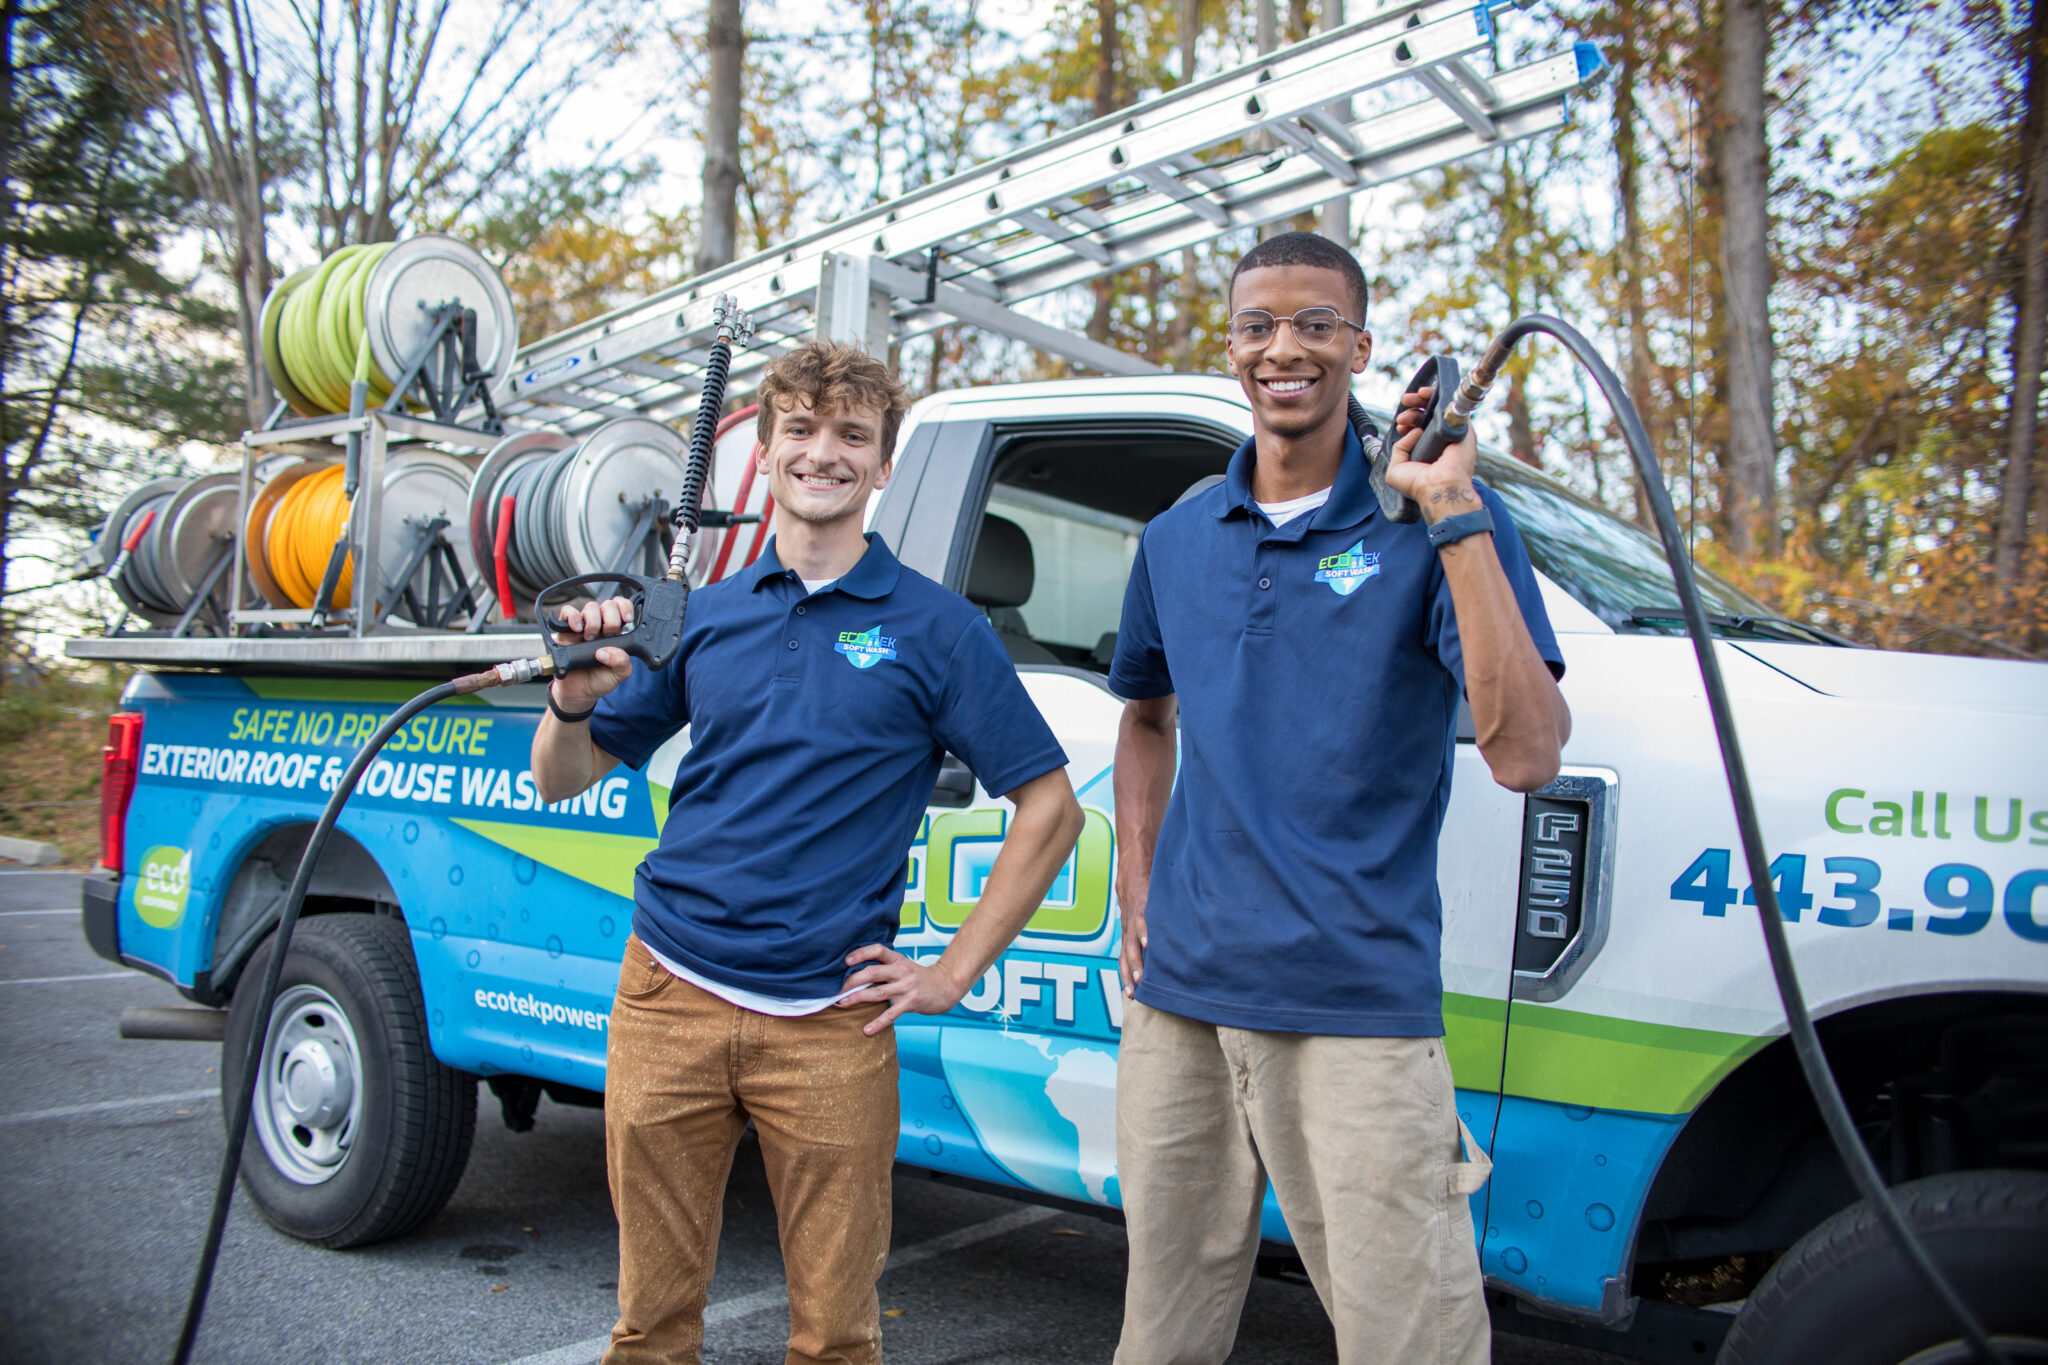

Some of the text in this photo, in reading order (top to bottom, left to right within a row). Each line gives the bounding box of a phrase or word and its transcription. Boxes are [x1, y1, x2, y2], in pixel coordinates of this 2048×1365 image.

[1319, 552, 1380, 570] ECOTEK
[1325, 569, 1349, 578] SOFT
[838, 631, 897, 649] ECOTEK
[843, 643, 889, 655] SOFT WASH
[229, 708, 493, 756] SAFE NO PRSSURE
[141, 743, 248, 783] EXTERIOR
[246, 751, 322, 789] ROOF
[320, 756, 343, 792] &
[462, 767, 629, 819] WASNG
[1554, 779, 1582, 790] XL
[1824, 788, 1952, 840] Call
[145, 861, 187, 895] eco
[899, 808, 1114, 940] CO
[1526, 812, 1579, 939] F250
[474, 989, 610, 1032] ecotekpower
[917, 954, 1089, 1024] OFT
